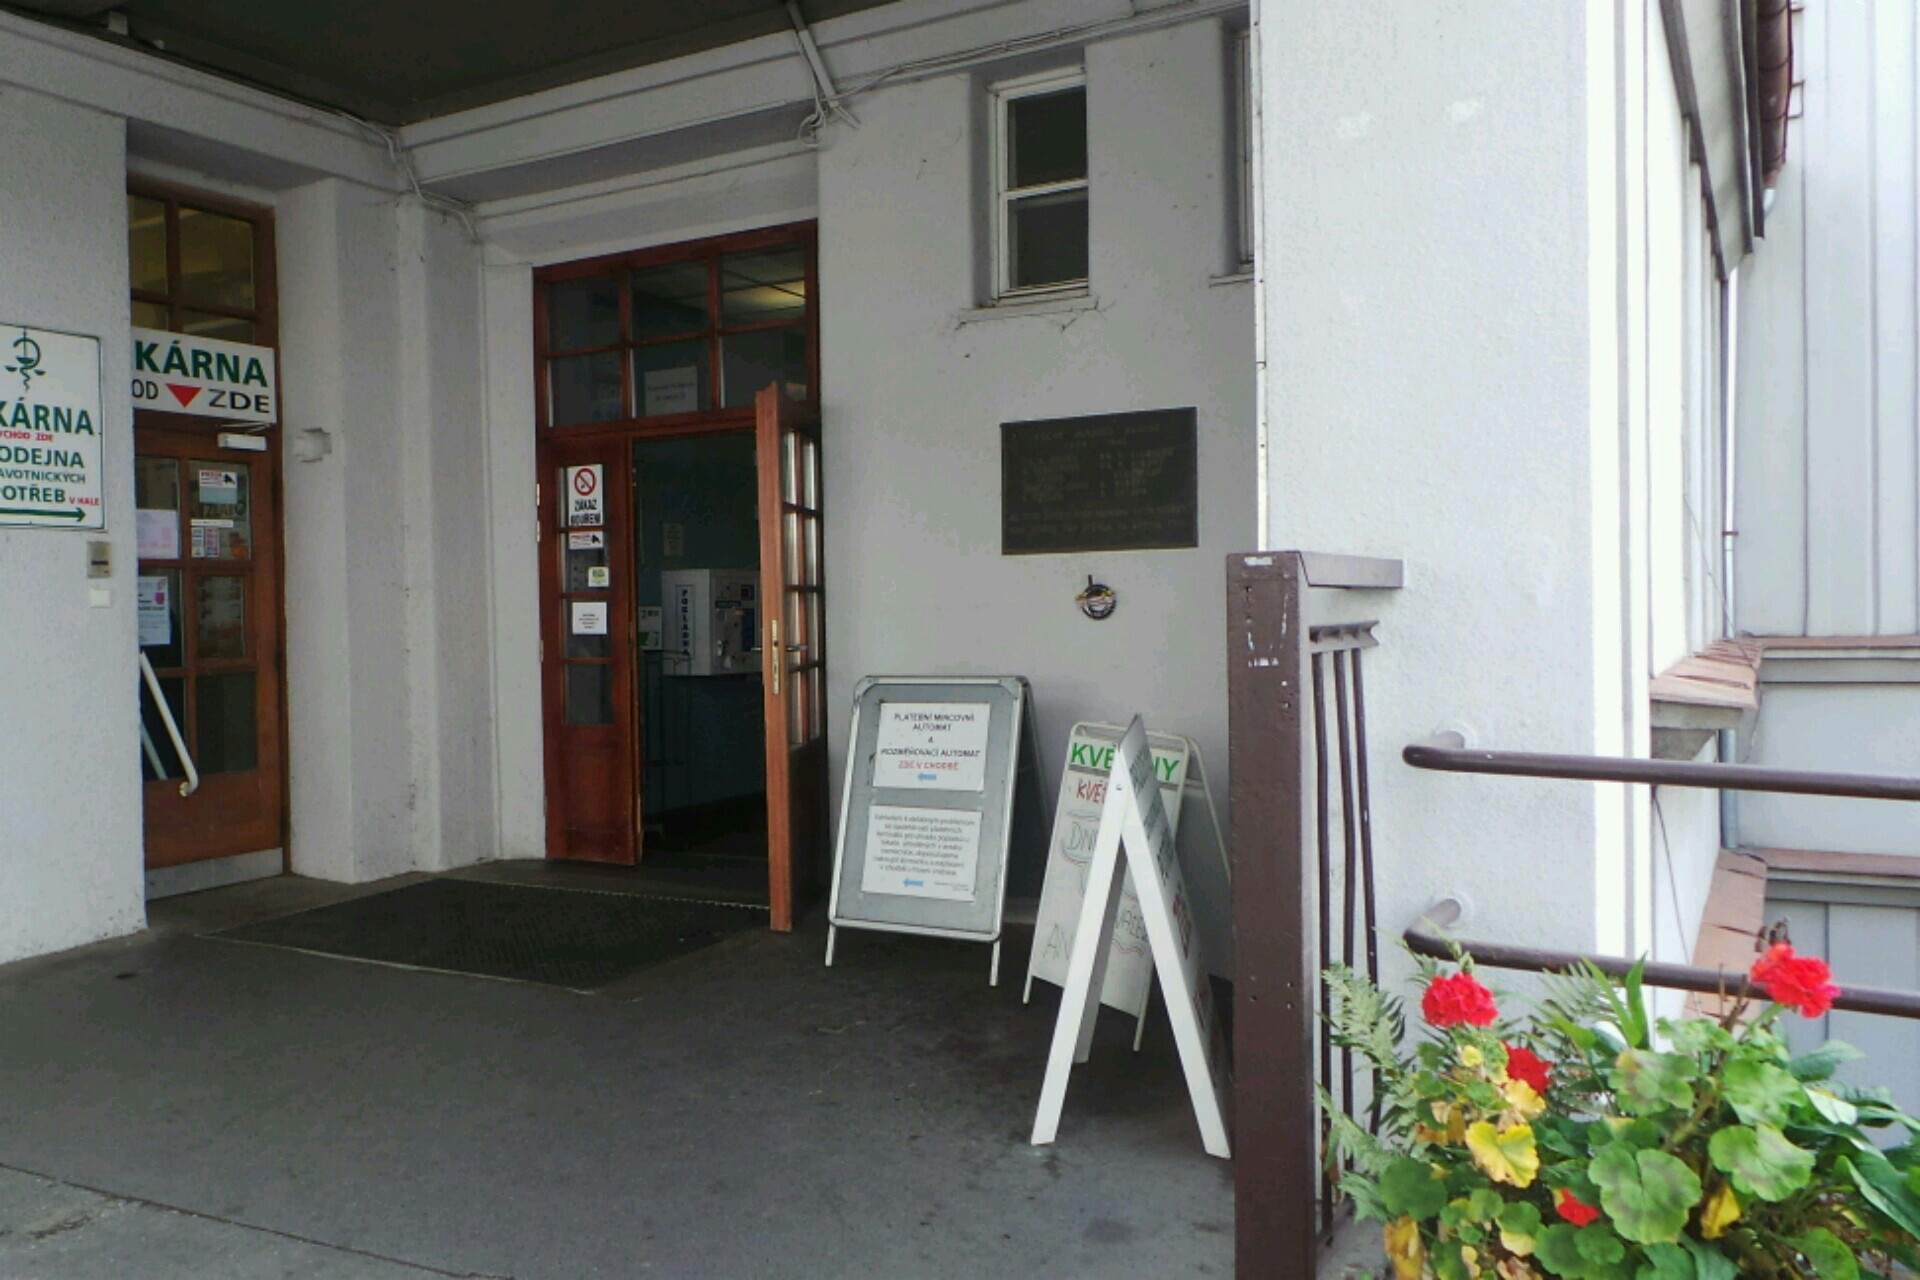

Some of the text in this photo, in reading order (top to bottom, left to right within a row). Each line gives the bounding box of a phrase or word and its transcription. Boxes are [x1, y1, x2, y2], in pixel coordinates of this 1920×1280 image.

[134, 339, 268, 388] KÁRNA
[208, 388, 270, 413] ZDE
[913, 723, 952, 731] AUTOMAT
[940, 749, 980, 757] AUTOMAT
